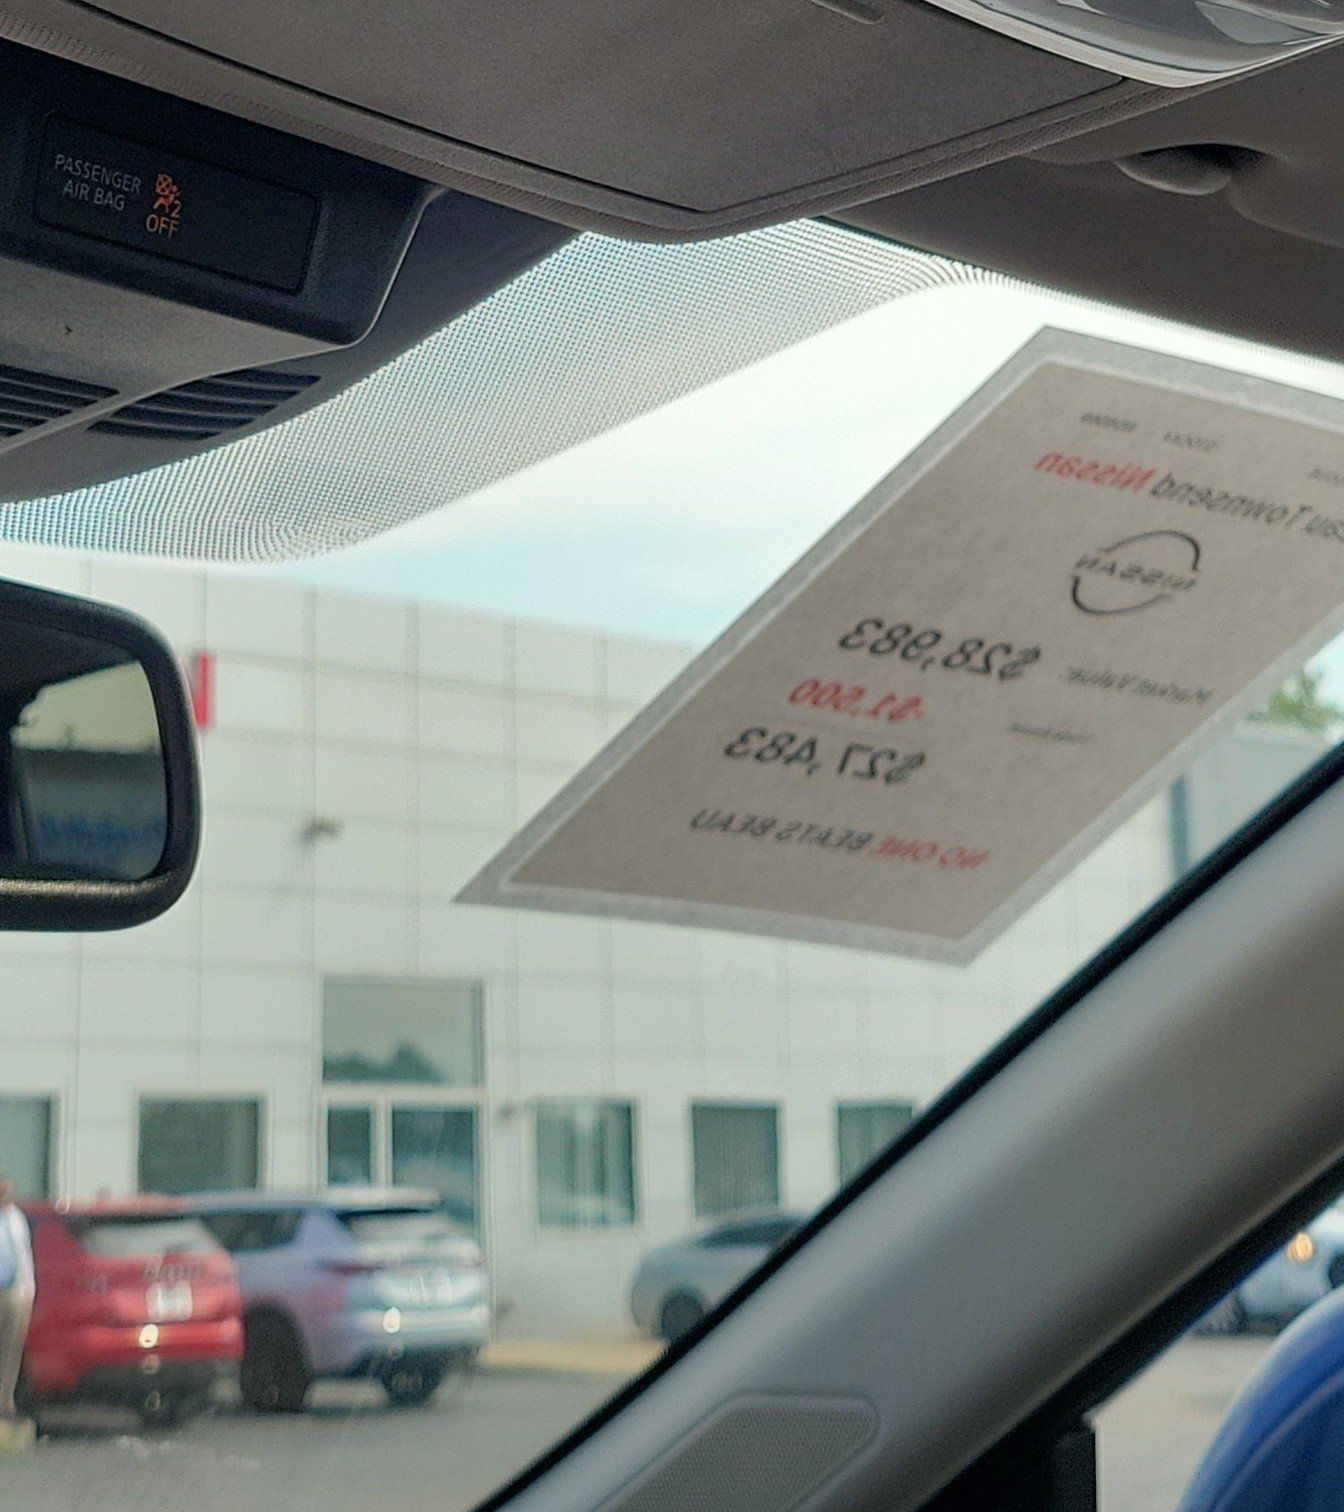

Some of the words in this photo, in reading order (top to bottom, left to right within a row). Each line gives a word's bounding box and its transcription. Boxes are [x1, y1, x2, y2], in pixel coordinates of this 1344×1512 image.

[54, 154, 142, 194] PASSENGER
[61, 179, 90, 202] AIR
[93, 188, 126, 212] BAG
[146, 213, 179, 239] OFF
